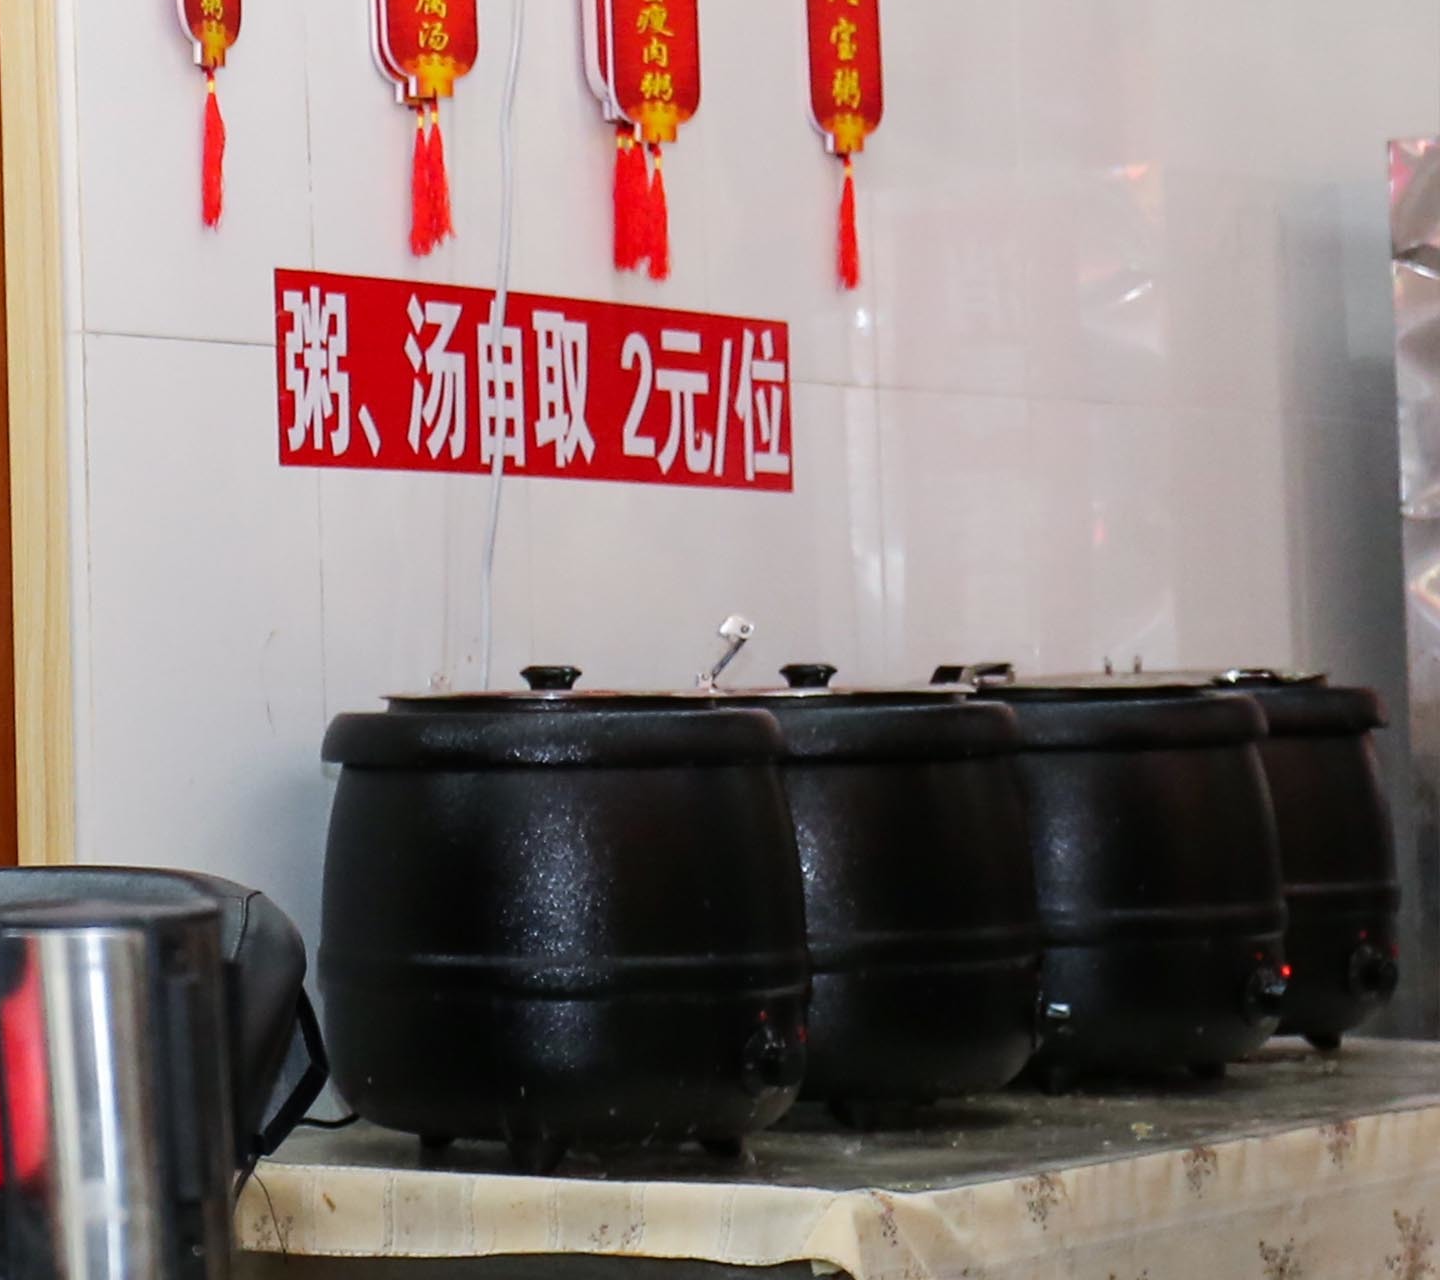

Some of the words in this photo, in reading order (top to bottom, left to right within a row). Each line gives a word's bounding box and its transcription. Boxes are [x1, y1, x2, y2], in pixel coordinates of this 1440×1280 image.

[283, 286, 595, 469] 粥、汤自取
[621, 328, 790, 481] 2元/位
